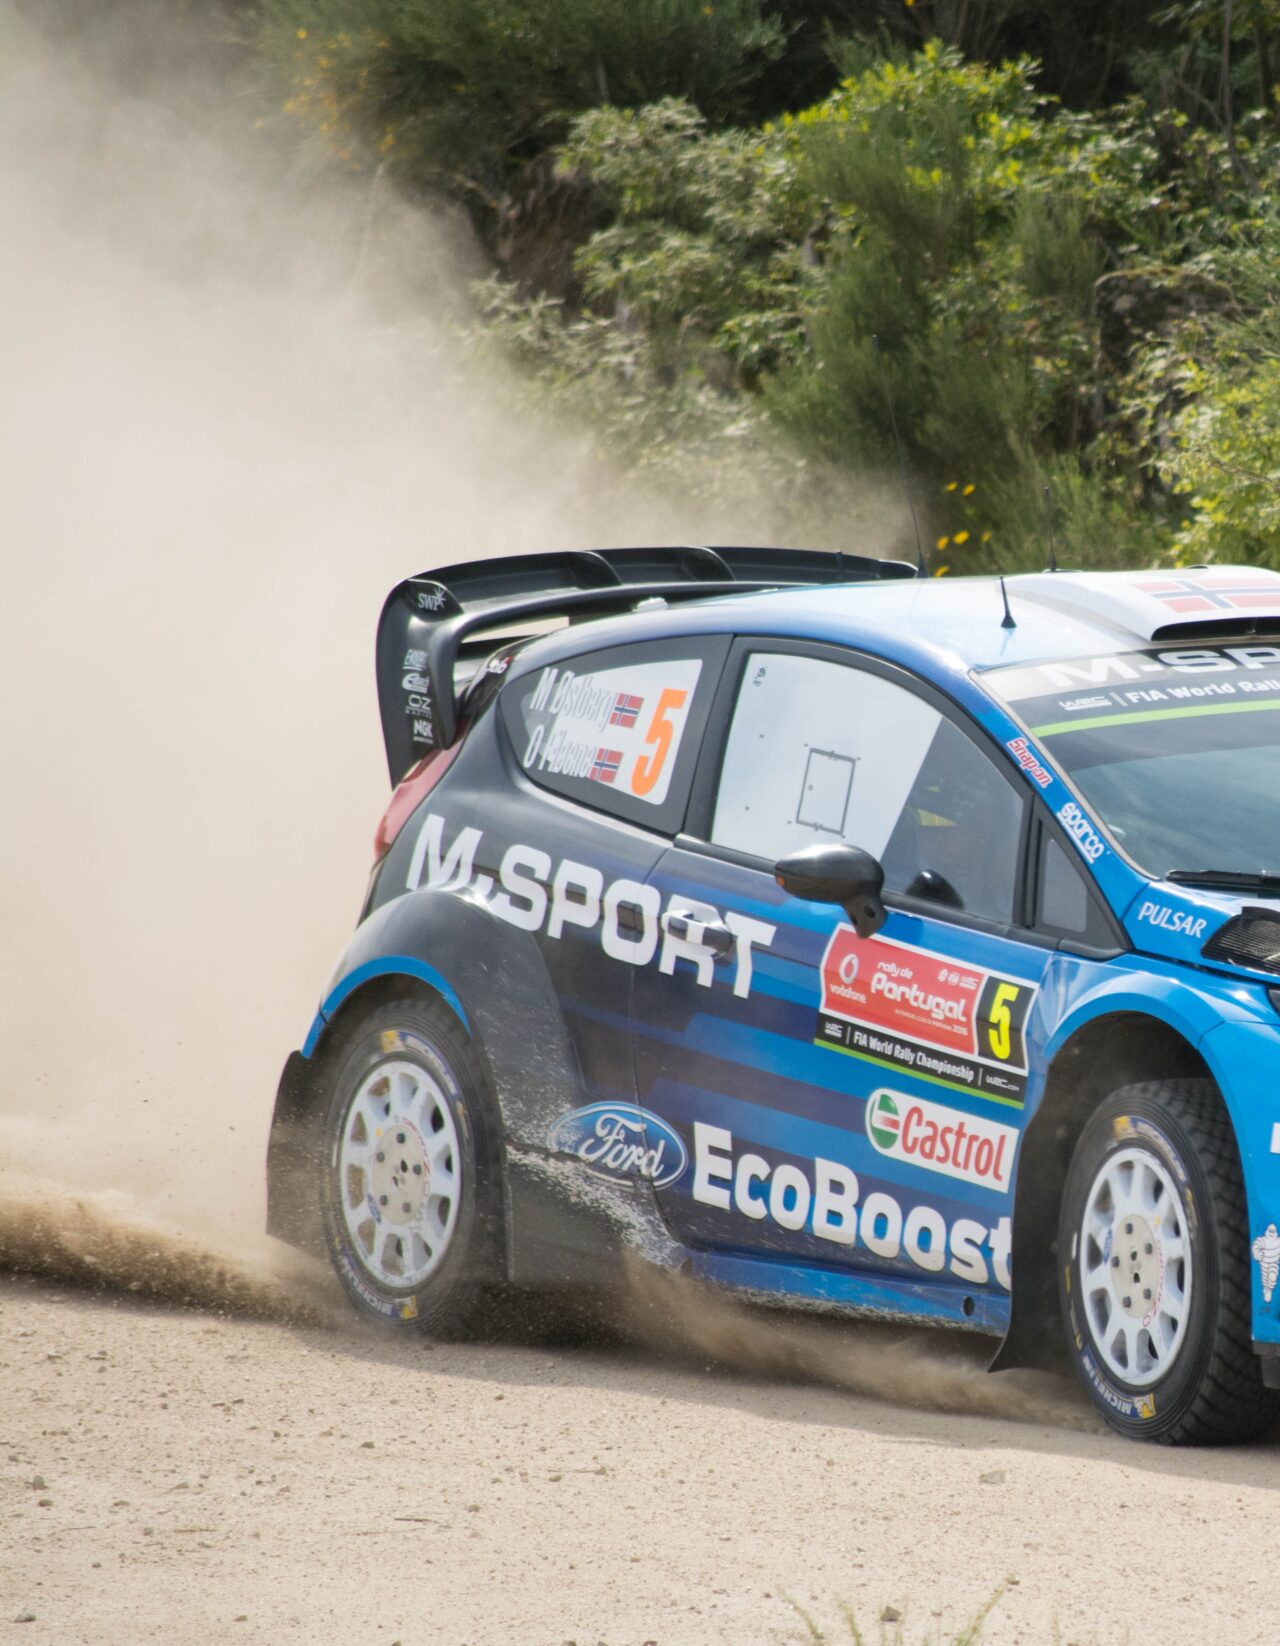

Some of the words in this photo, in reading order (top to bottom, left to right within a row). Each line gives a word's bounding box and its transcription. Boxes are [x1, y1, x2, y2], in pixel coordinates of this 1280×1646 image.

[529, 667, 559, 711] M
[1128, 690, 1168, 704] FIA
[1166, 682, 1236, 698] World
[413, 719, 433, 738] NGK
[631, 687, 688, 797] 5
[1006, 737, 1053, 789] Snap-on
[1059, 801, 1105, 862] sparco
[406, 813, 777, 999] M-SPORT
[1138, 902, 1207, 938] PULSAR
[877, 962, 901, 977] rally
[900, 967, 914, 979] de
[870, 972, 968, 1022] Portugal
[988, 982, 1020, 1060] 5
[853, 1031, 868, 1048] FIA
[868, 1036, 894, 1056] World
[894, 1044, 916, 1065] Rally
[916, 1051, 974, 1083] Championship
[577, 1113, 666, 1178] Ford
[901, 1106, 1007, 1181] Castrol
[1082, 1355, 1133, 1416] MICHELIN
